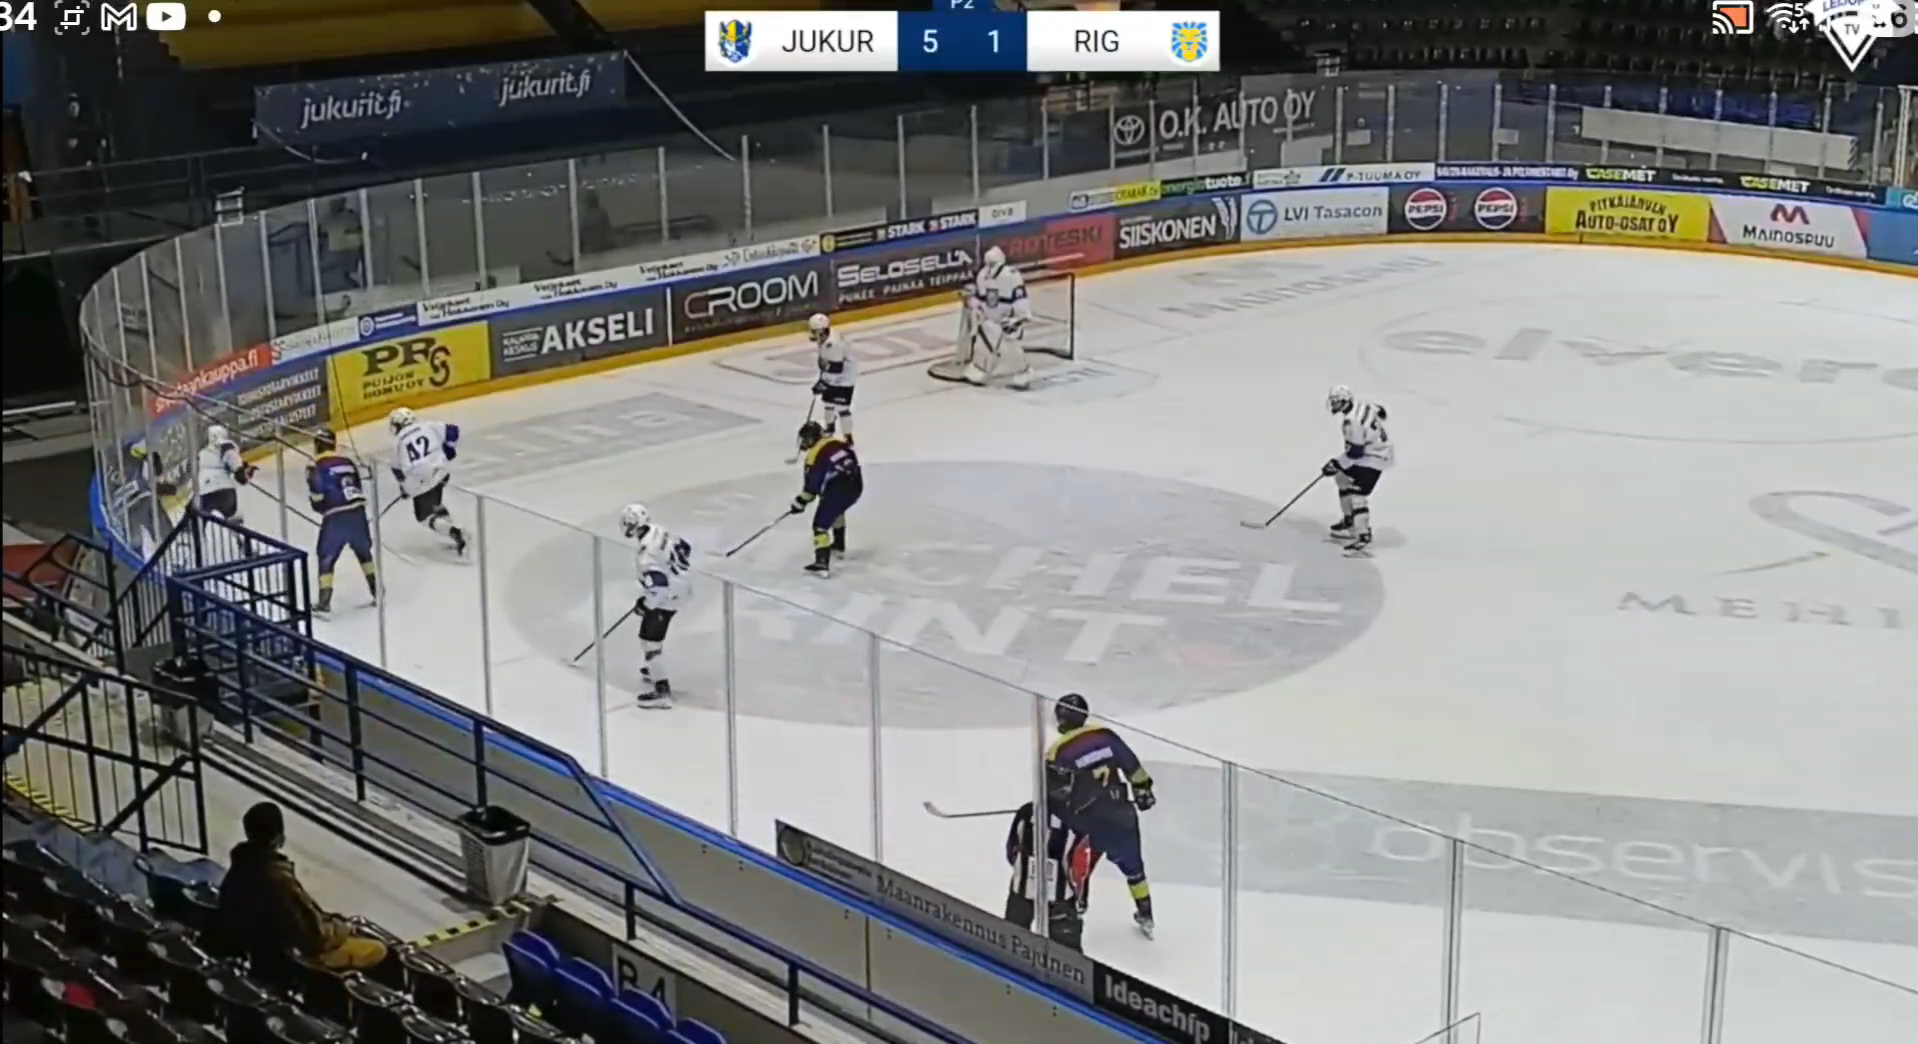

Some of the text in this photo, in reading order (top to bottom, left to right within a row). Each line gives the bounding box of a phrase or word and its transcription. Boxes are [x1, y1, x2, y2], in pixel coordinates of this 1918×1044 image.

[499, 68, 592, 107] jukurit.fi
[300, 88, 402, 128] jukurit.fi
[1158, 90, 1316, 140] O.K. AUTO OY
[939, 211, 976, 231] STARK
[1284, 204, 1384, 221] LVI Tasacon
[1407, 204, 1444, 214] PEPSI
[1477, 204, 1514, 214] PEPSI
[887, 219, 925, 239] STARK
[1118, 213, 1217, 249] SIISKONEN
[684, 270, 819, 319] CROOM
[541, 307, 654, 354] AKSELI
[405, 434, 431, 464] 42
[1092, 765, 1111, 788] 7
[876, 873, 1086, 986] Maanrakennus Pajunen
[1104, 974, 1211, 1044] Ideachip
